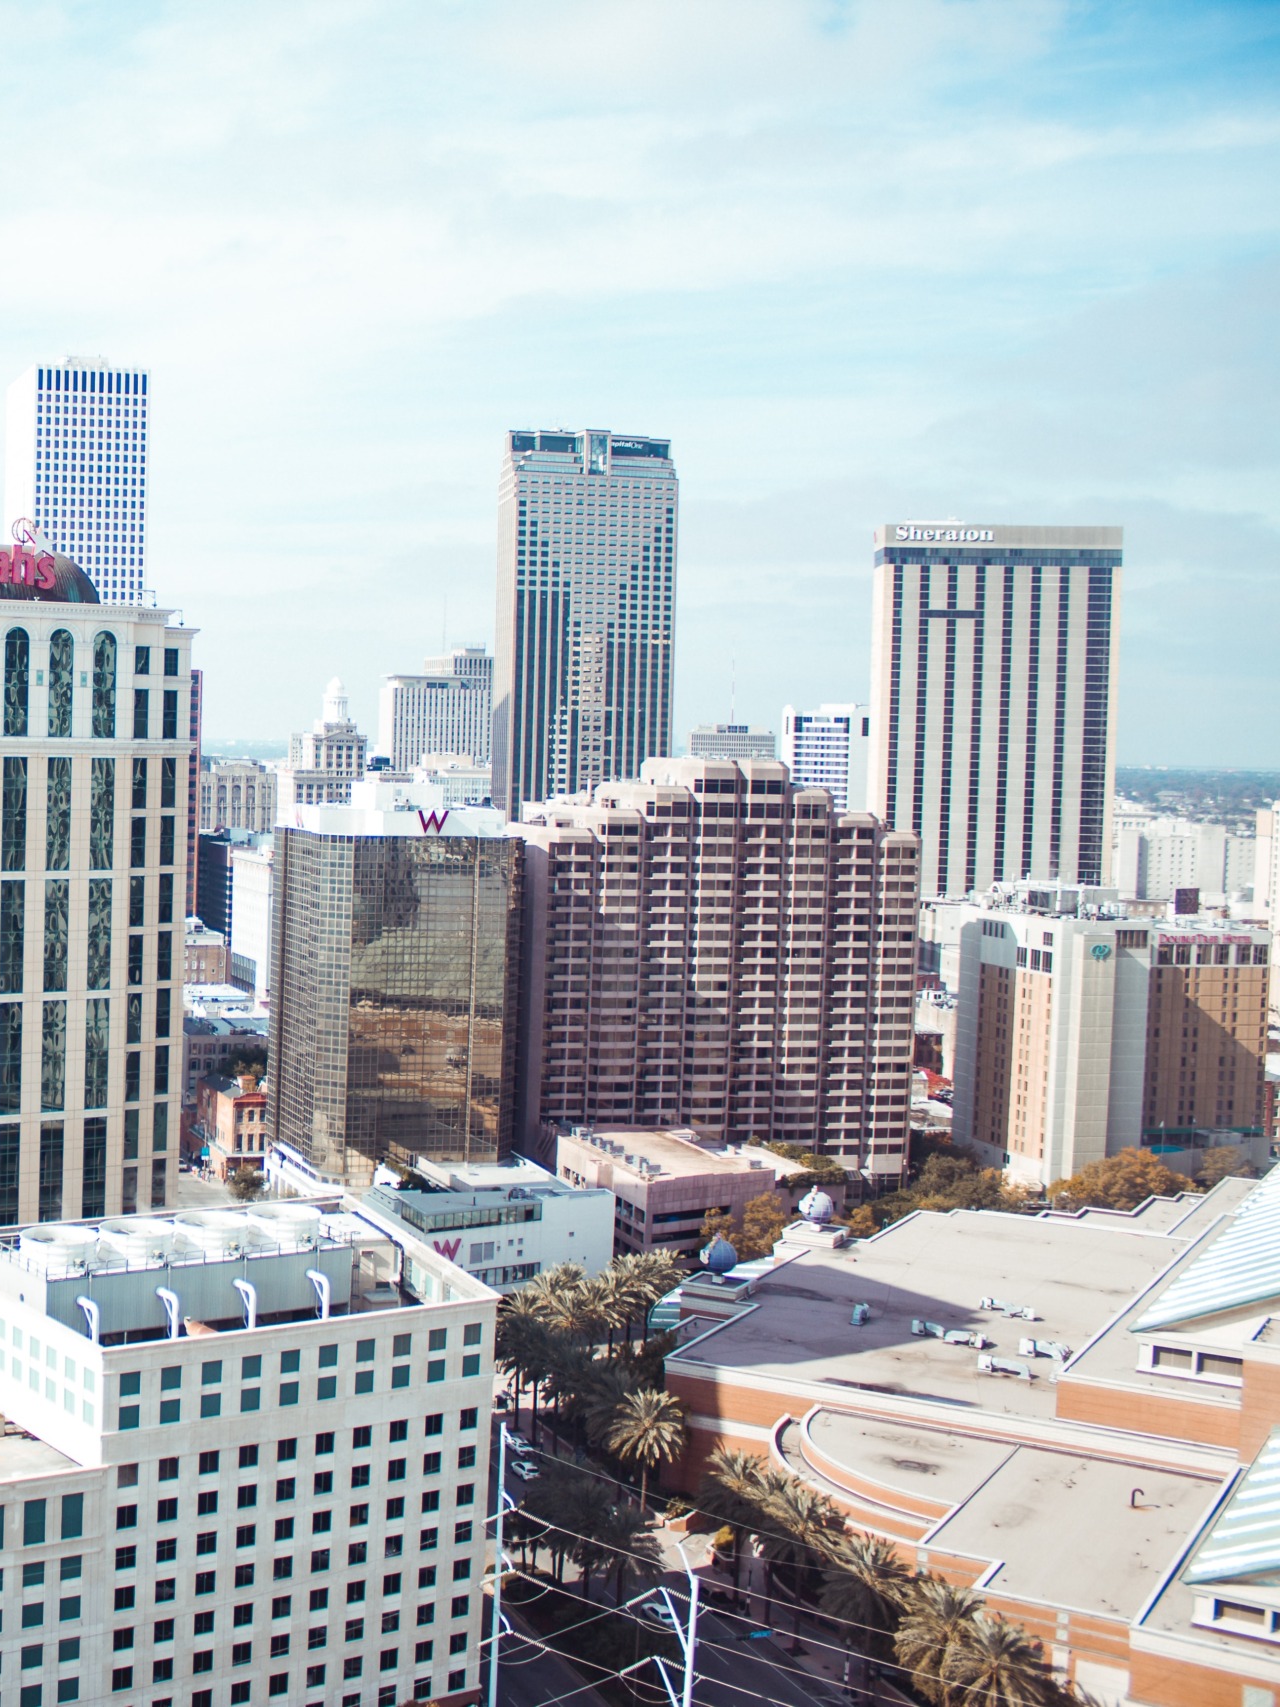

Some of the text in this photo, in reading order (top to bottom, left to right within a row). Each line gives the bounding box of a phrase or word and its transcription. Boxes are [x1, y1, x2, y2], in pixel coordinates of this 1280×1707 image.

[895, 525, 994, 542] Sheraton
[418, 810, 449, 834] W
[433, 1238, 462, 1262] W
